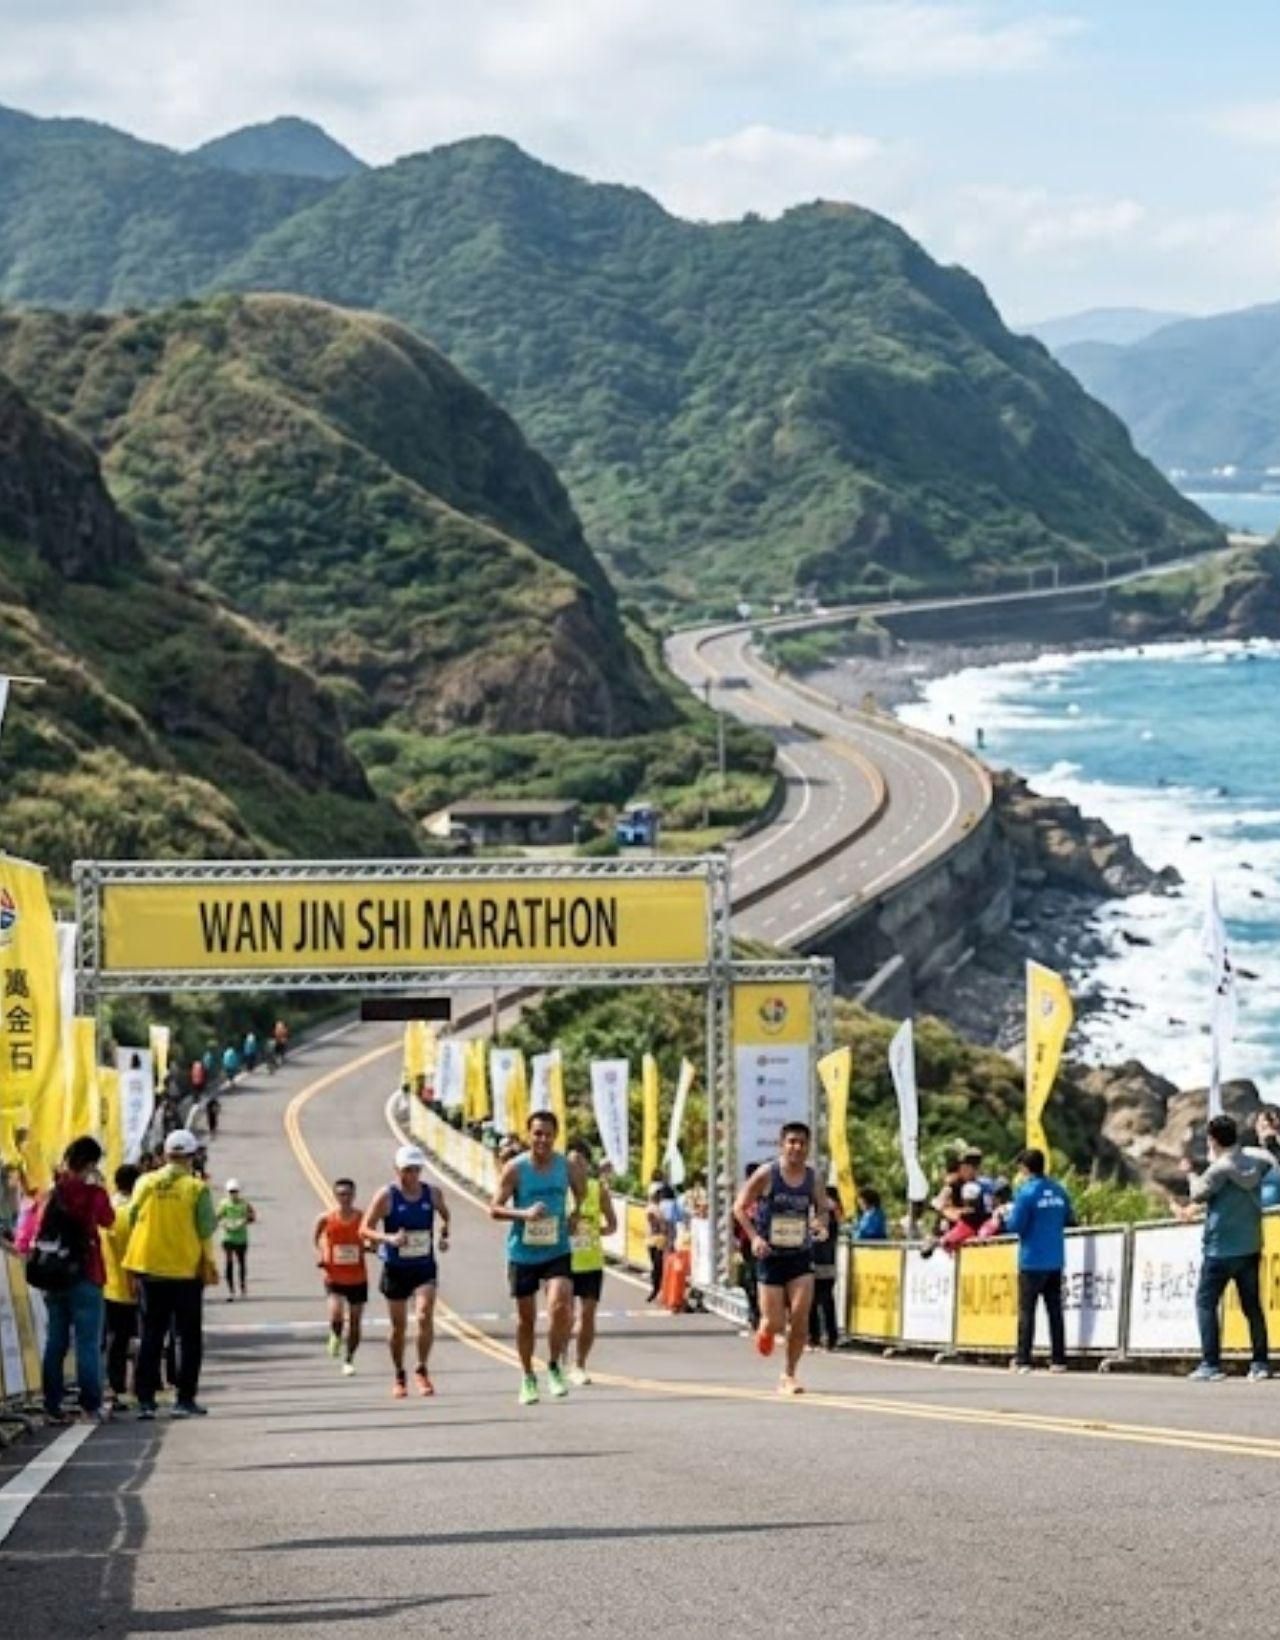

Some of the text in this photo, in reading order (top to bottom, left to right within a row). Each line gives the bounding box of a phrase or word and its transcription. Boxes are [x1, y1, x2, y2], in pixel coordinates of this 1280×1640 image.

[200, 896, 618, 953] WAN JIN SHI MARATHON
